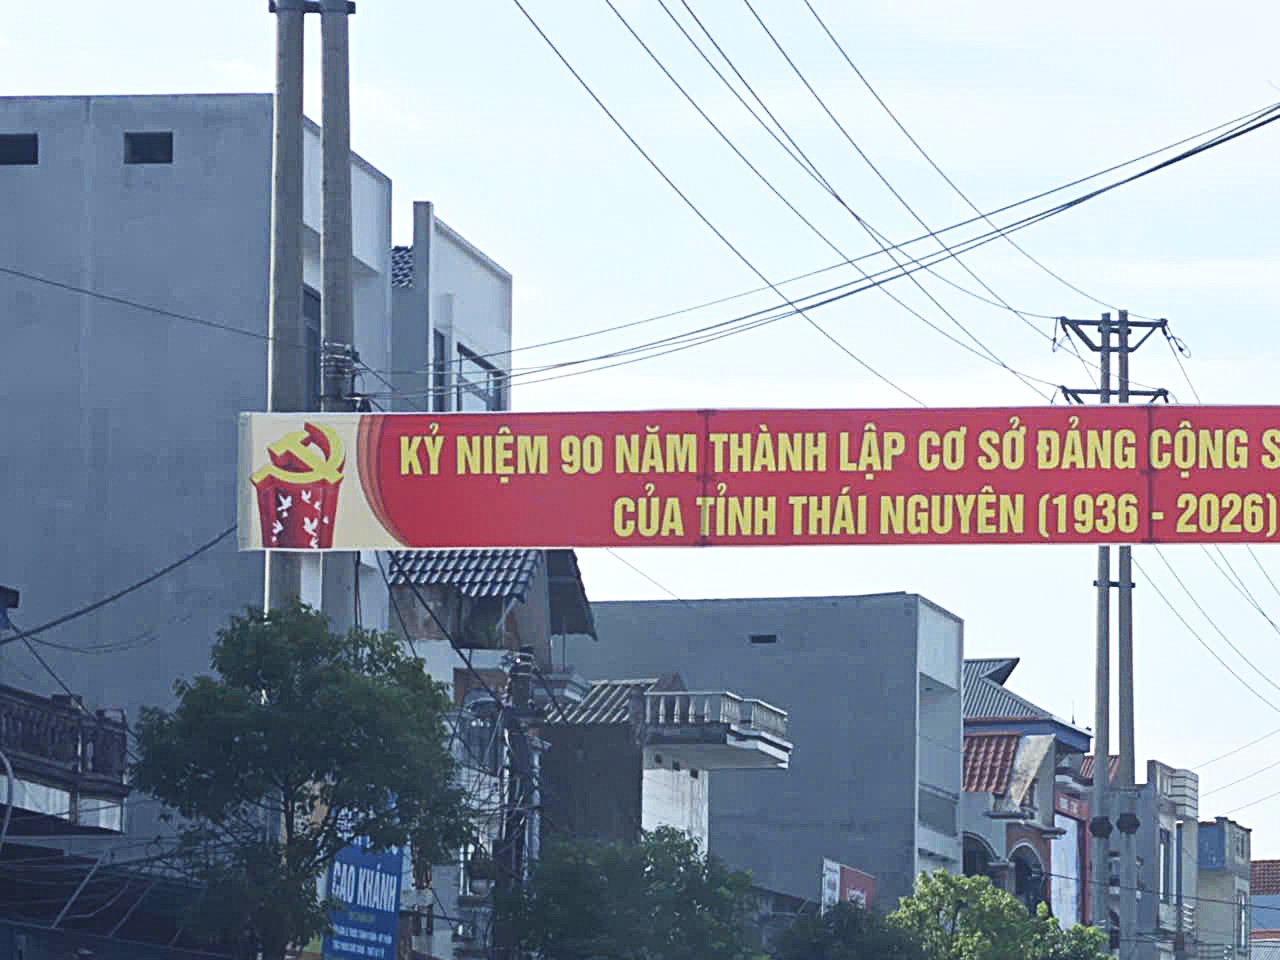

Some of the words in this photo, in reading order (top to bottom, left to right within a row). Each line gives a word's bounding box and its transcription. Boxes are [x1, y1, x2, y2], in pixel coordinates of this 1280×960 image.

[399, 424, 444, 475] KỶ
[456, 427, 549, 484] NIỆM
[560, 433, 603, 474] 90
[615, 426, 697, 474] NĂM
[709, 425, 827, 473] THÀNH
[839, 422, 905, 480] LẬP
[918, 427, 967, 471] CƠ
[977, 416, 1027, 470] SỞ
[1036, 416, 1137, 470] ĐẢNG
[1149, 420, 1249, 479] CỘNG
[613, 484, 685, 537] CỦA
[695, 482, 776, 537] TỈNH
[788, 487, 867, 536] THÁI
[879, 485, 1025, 535] NGUYÊN
[1038, 491, 1139, 537] (1936
[1151, 511, 1164, 521] -
[331, 861, 355, 904] CAO
[357, 864, 397, 913] KHÁNH
